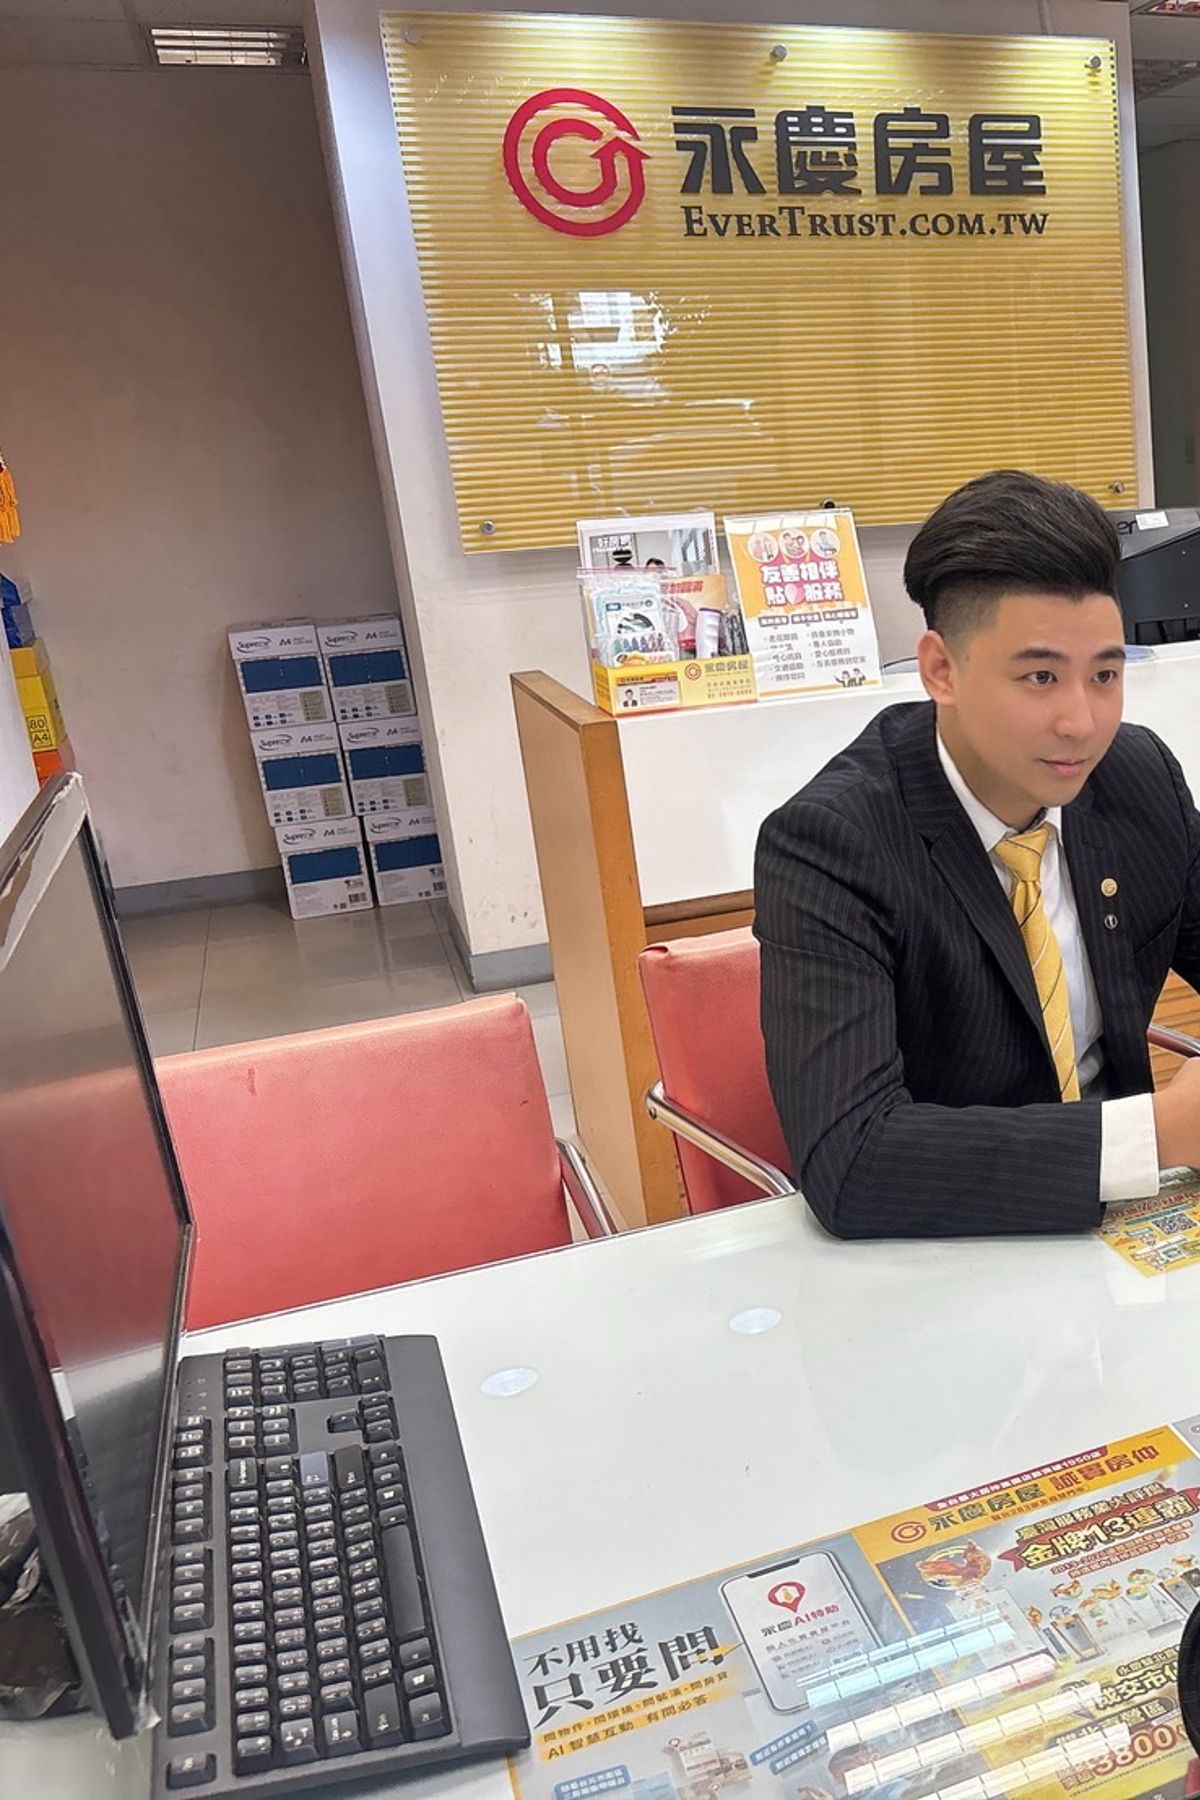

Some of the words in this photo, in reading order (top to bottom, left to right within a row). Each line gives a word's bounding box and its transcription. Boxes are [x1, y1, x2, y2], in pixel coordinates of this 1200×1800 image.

[671, 105, 1047, 197] 永慶房屋
[28, 717, 45, 728] 80
[33, 732, 49, 744] A4
[927, 1483, 1046, 1533] 永慶房屋
[1049, 1445, 1160, 1491] 誠實房仲
[1019, 1496, 1200, 1569] 金牌13連霸
[523, 1622, 644, 1677] 不用找
[533, 1626, 725, 1729] 只要問
[547, 1744, 565, 1760] AI
